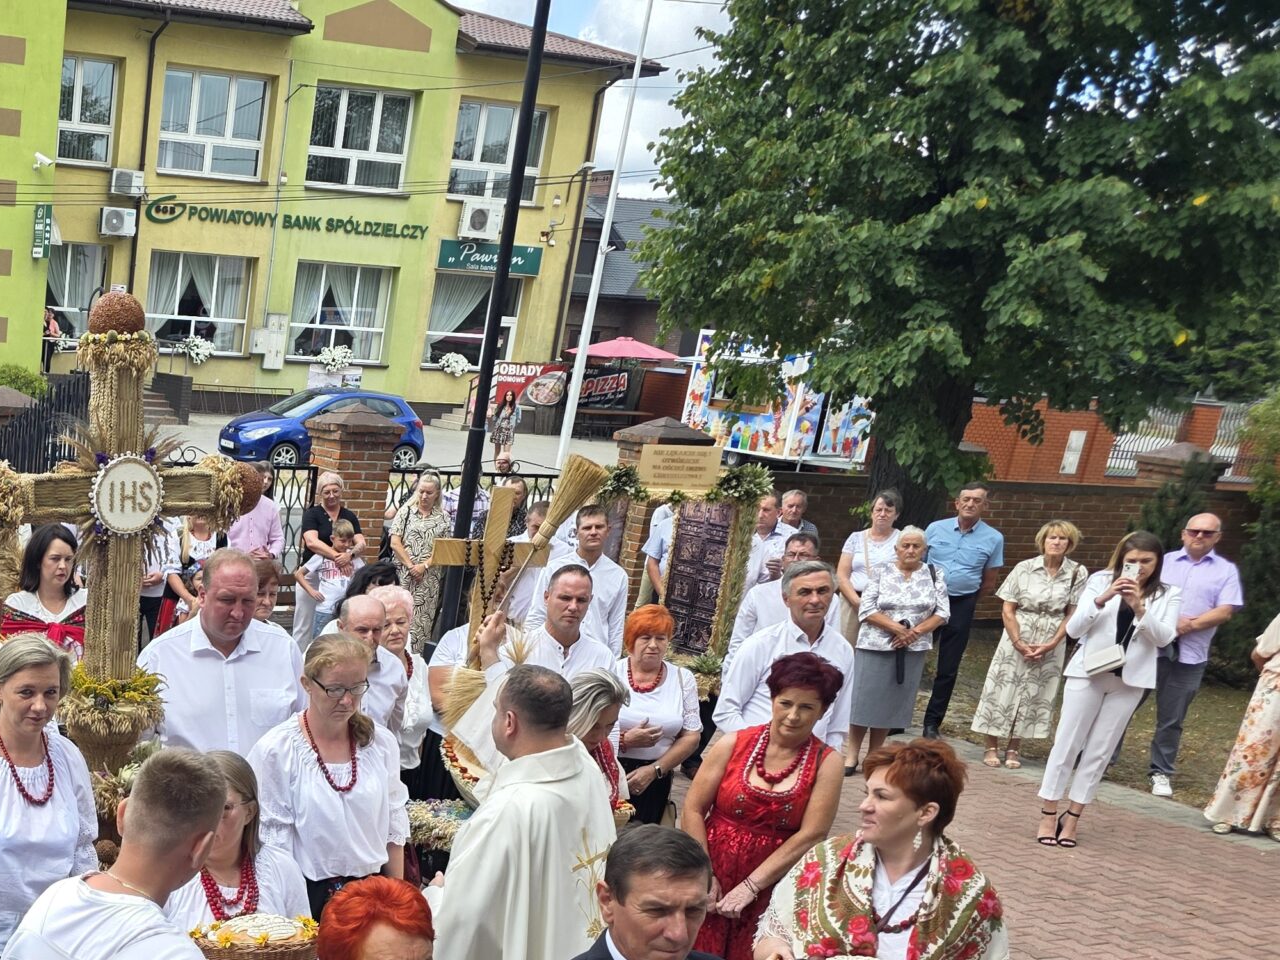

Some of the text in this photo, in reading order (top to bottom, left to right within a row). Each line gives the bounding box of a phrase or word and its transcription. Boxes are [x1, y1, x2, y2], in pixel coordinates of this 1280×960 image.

[187, 205, 429, 240] POWIATOWY BANK SPÓŁDZIELCZY
[499, 364, 544, 376] OBIADY
[581, 373, 628, 397] PIZZA
[109, 481, 153, 513] IHS
